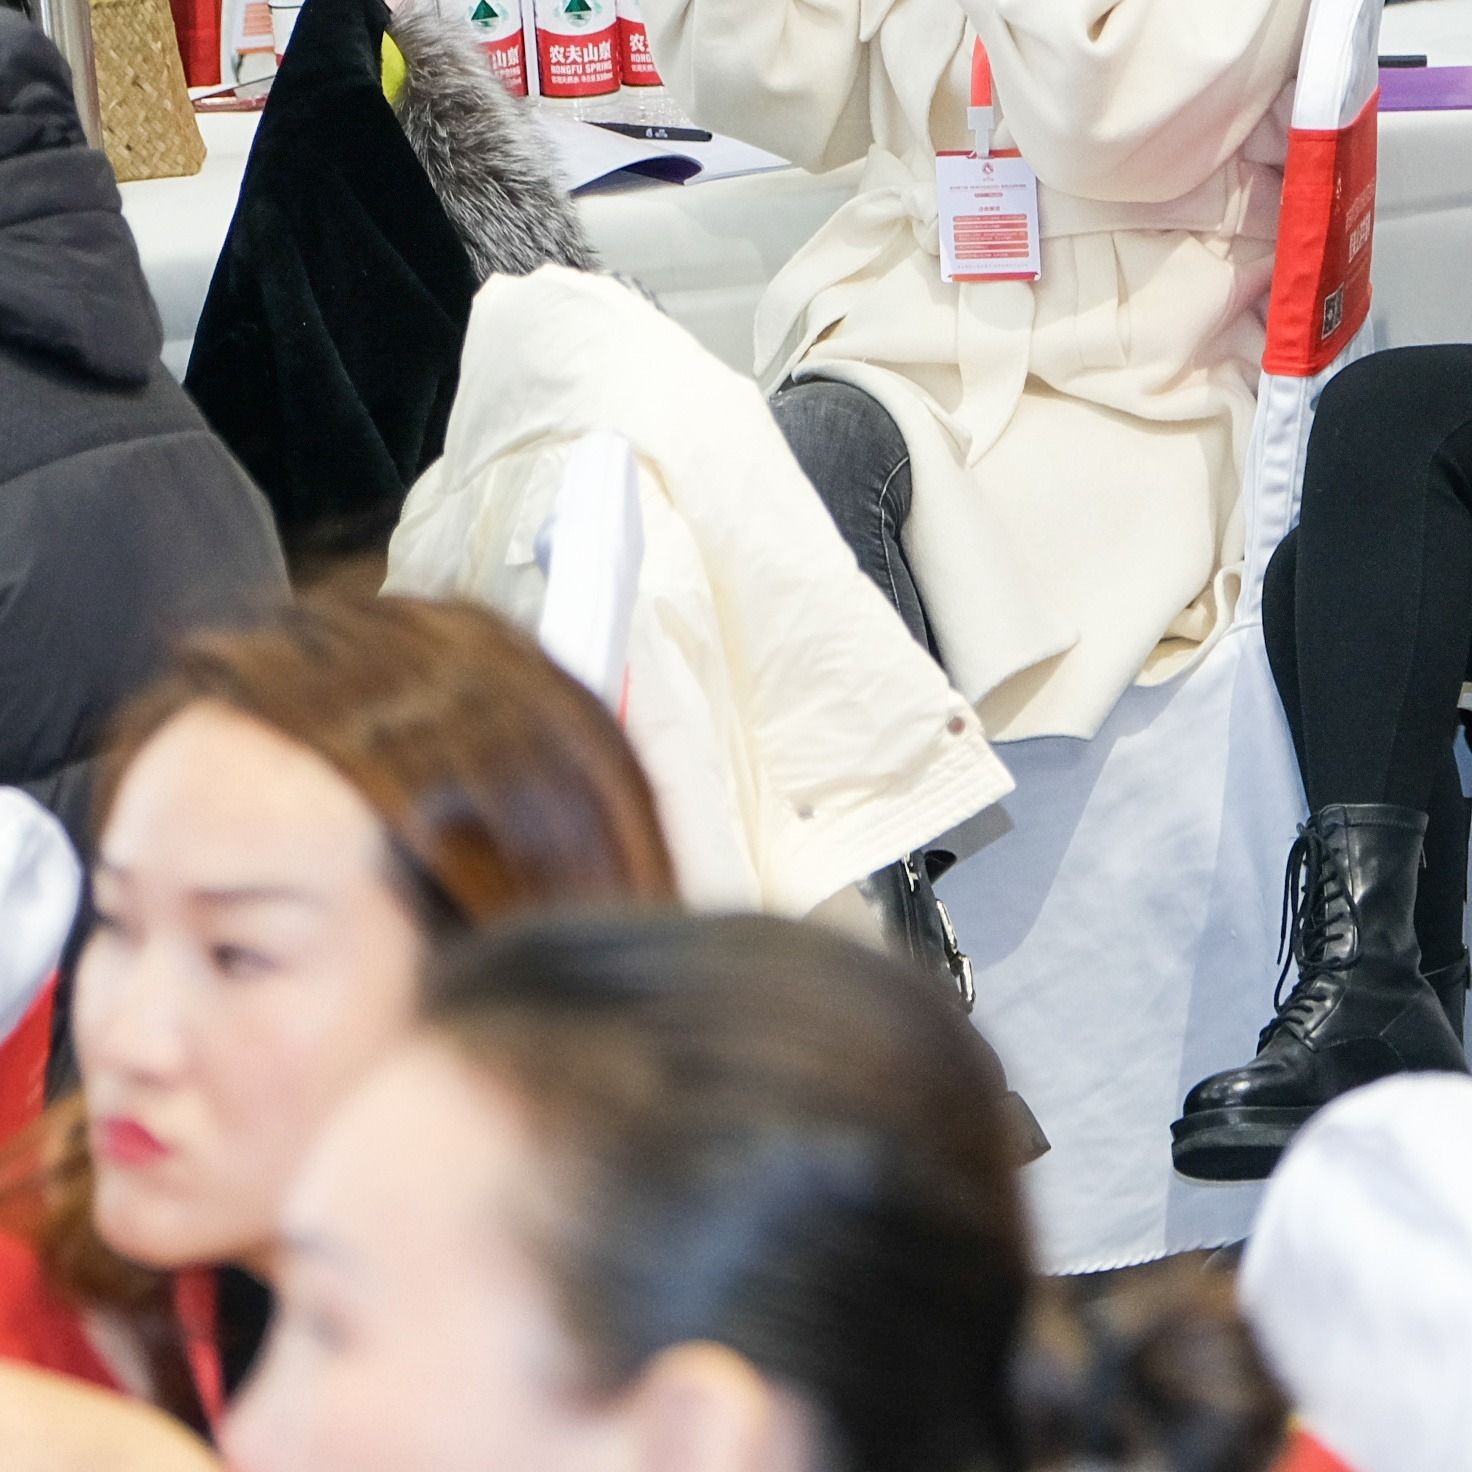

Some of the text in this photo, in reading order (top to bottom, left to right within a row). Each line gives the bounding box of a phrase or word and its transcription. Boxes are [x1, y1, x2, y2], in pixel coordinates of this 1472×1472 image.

[549, 39, 612, 64] 农夫山泉
[585, 60, 613, 74] SPRING
